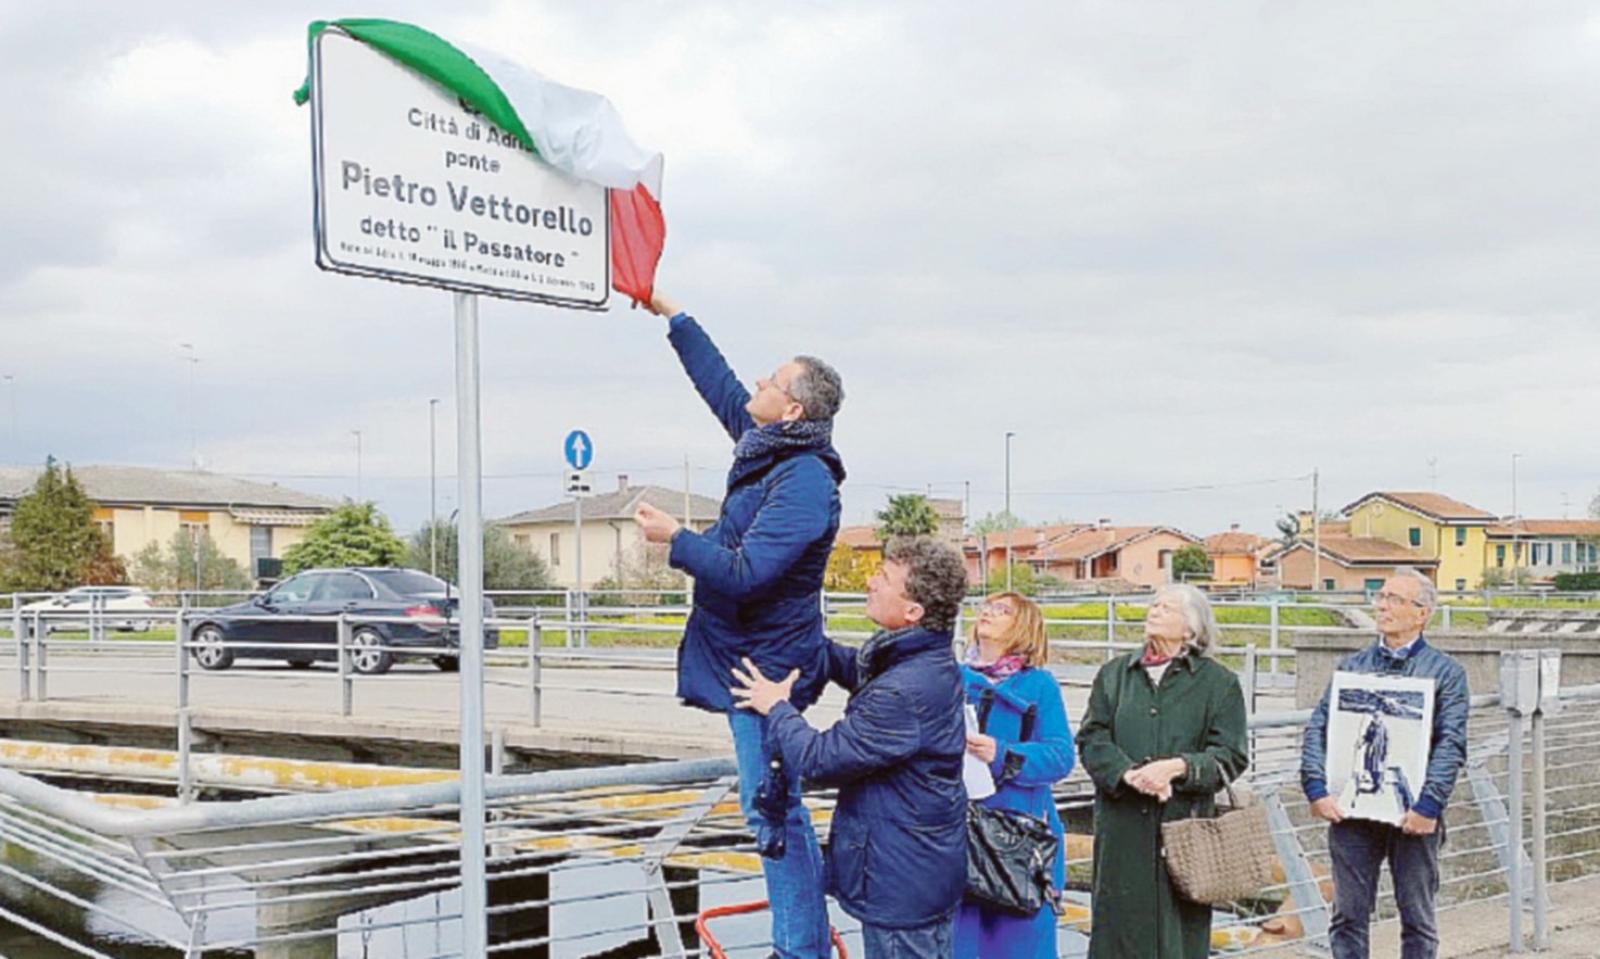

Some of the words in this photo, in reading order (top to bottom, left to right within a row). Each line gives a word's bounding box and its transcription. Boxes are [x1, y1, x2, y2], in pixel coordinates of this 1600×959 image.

[407, 107, 459, 136] Città
[465, 121, 481, 141] di
[486, 125, 534, 152] Adri
[445, 150, 501, 173] ponte
[341, 160, 437, 206] Pietro
[446, 181, 593, 236] Vettorello
[360, 215, 421, 243] detto
[463, 231, 565, 268] Passatore
